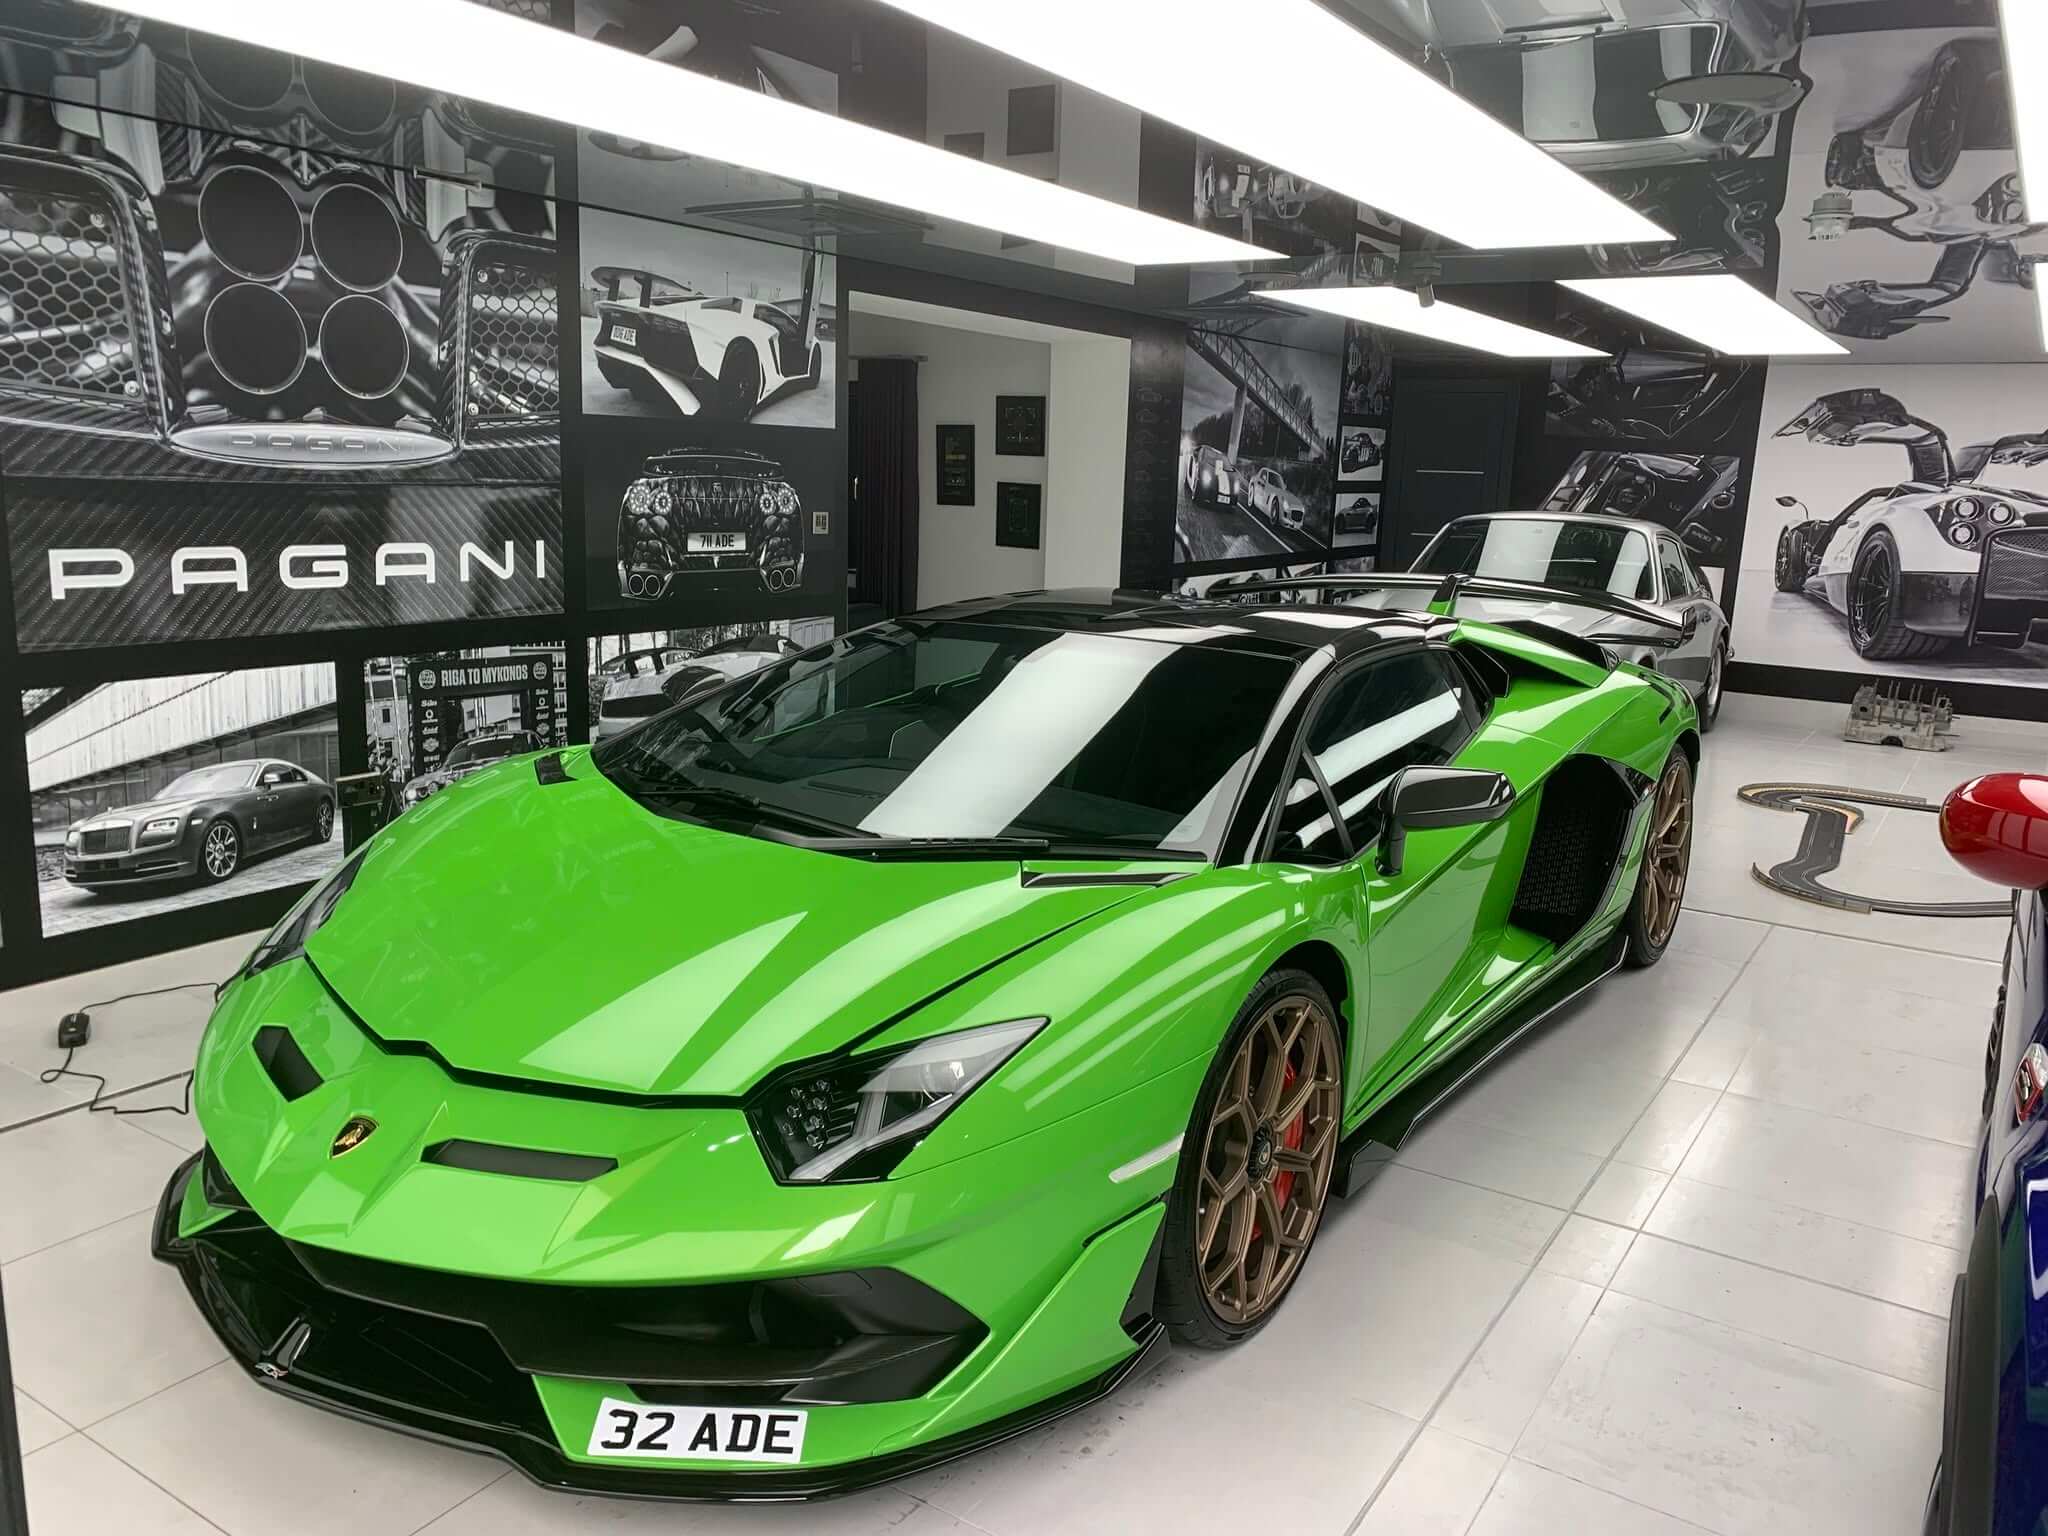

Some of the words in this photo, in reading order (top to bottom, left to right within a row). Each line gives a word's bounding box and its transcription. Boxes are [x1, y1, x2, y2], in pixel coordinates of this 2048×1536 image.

[715, 534, 735, 547] ADE
[47, 539, 547, 600] PAGANI
[441, 668, 466, 687] RIGA
[467, 668, 480, 685] TO
[482, 664, 528, 684] MYKONOS
[600, 1408, 676, 1451] 32
[687, 1412, 799, 1454] ADE
